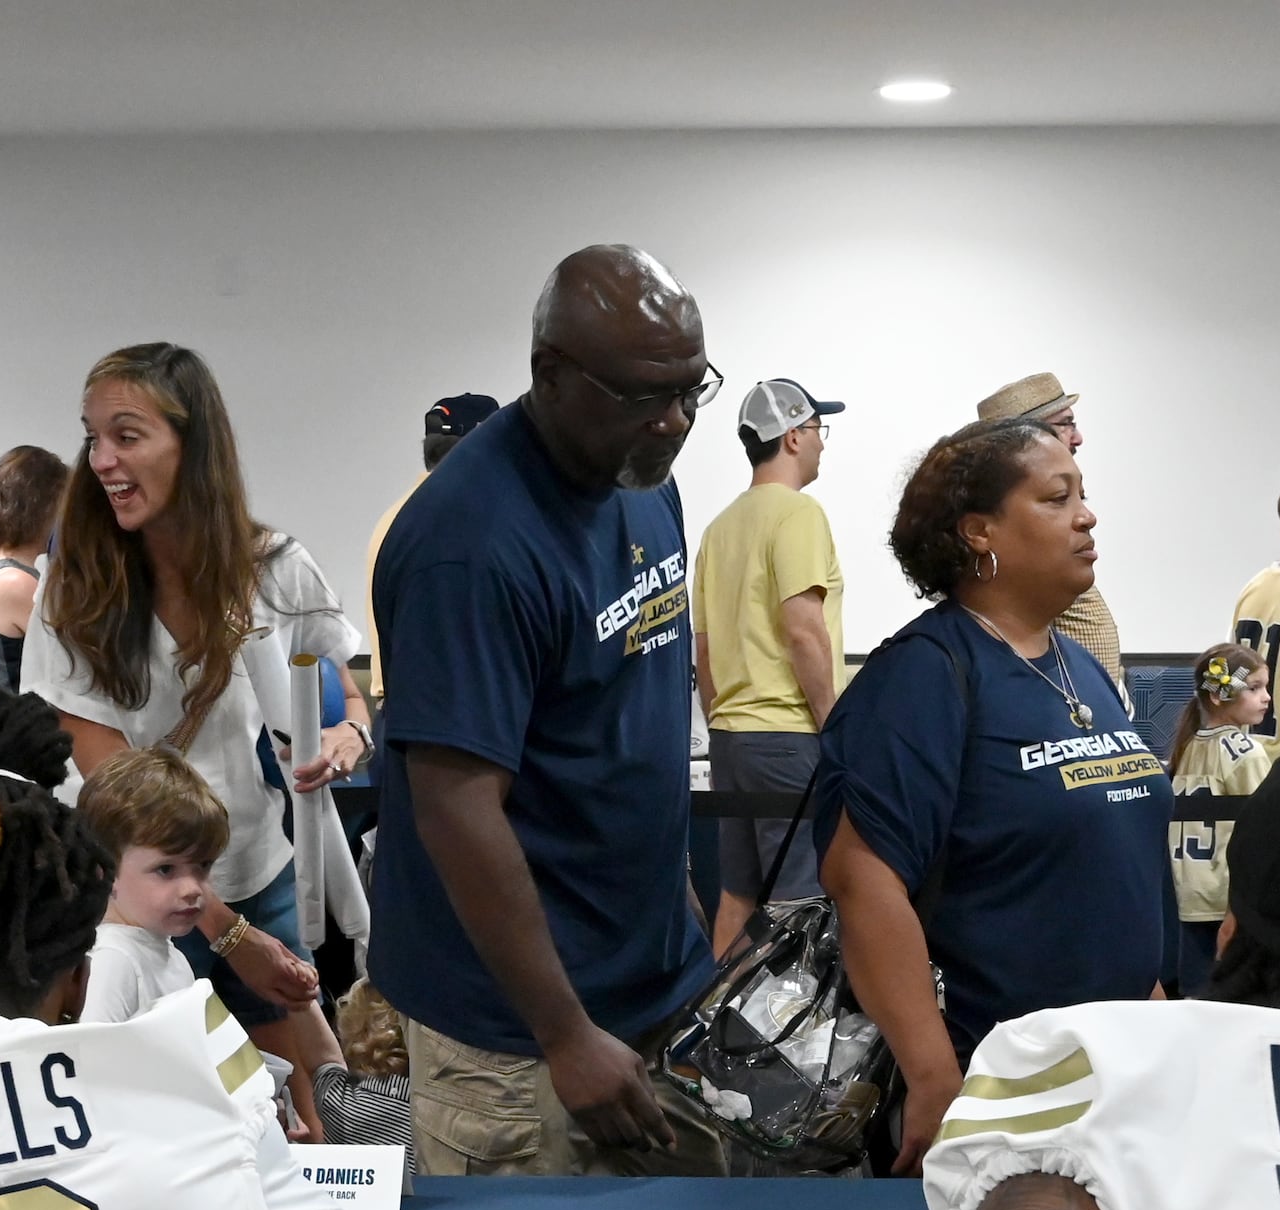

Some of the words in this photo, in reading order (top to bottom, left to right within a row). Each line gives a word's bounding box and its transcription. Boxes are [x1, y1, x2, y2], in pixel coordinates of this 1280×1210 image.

[1020, 733, 1121, 771] GEORGIA
[1222, 732, 1254, 761] 13
[1065, 766, 1113, 782] YELLOW
[1117, 759, 1160, 775] JACKETS
[1106, 785, 1151, 802] FOOTBALL
[316, 1168, 375, 1185] DANIELS
[336, 1191, 356, 1200] BACK
